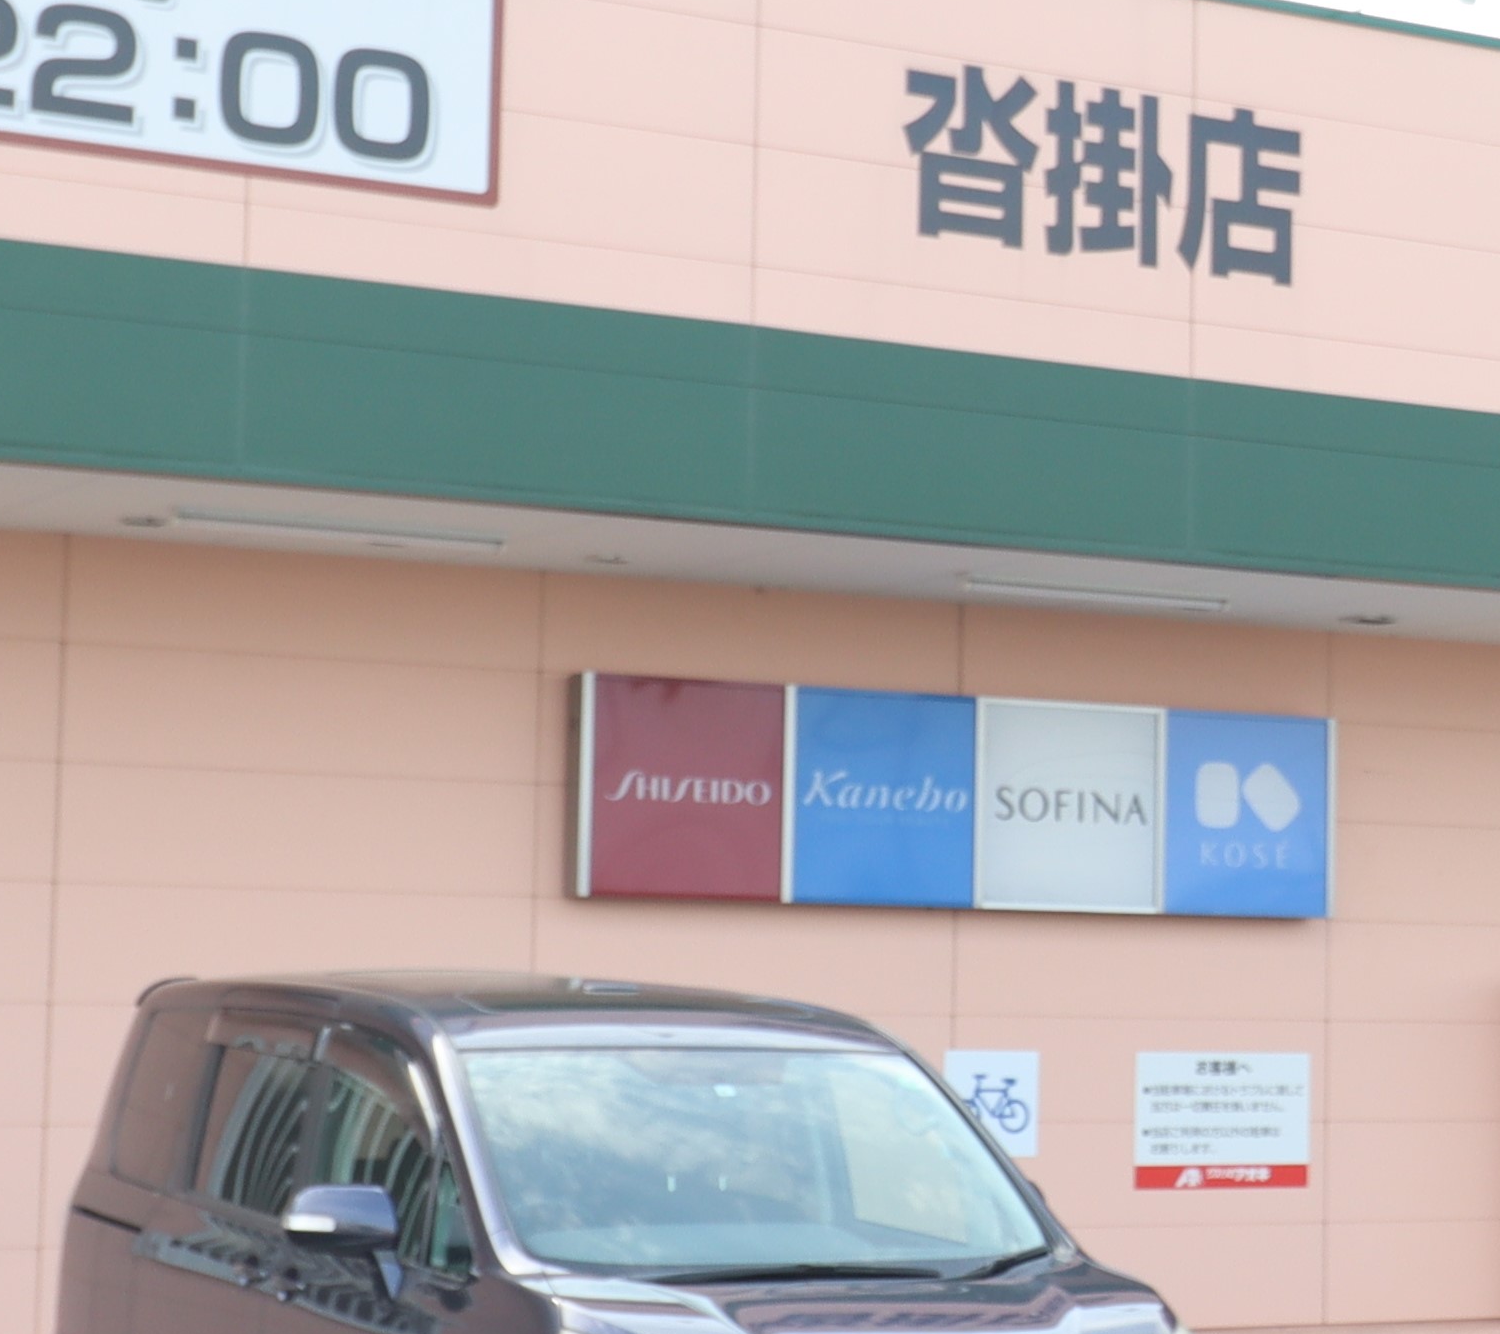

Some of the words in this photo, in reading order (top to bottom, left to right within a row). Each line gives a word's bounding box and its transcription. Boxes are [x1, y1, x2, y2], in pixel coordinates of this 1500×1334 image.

[903, 65, 1301, 287] 沓掛店
[604, 769, 773, 807] SHISEIDO
[802, 768, 970, 814] Kanebo
[994, 783, 1148, 827] SOFINA
